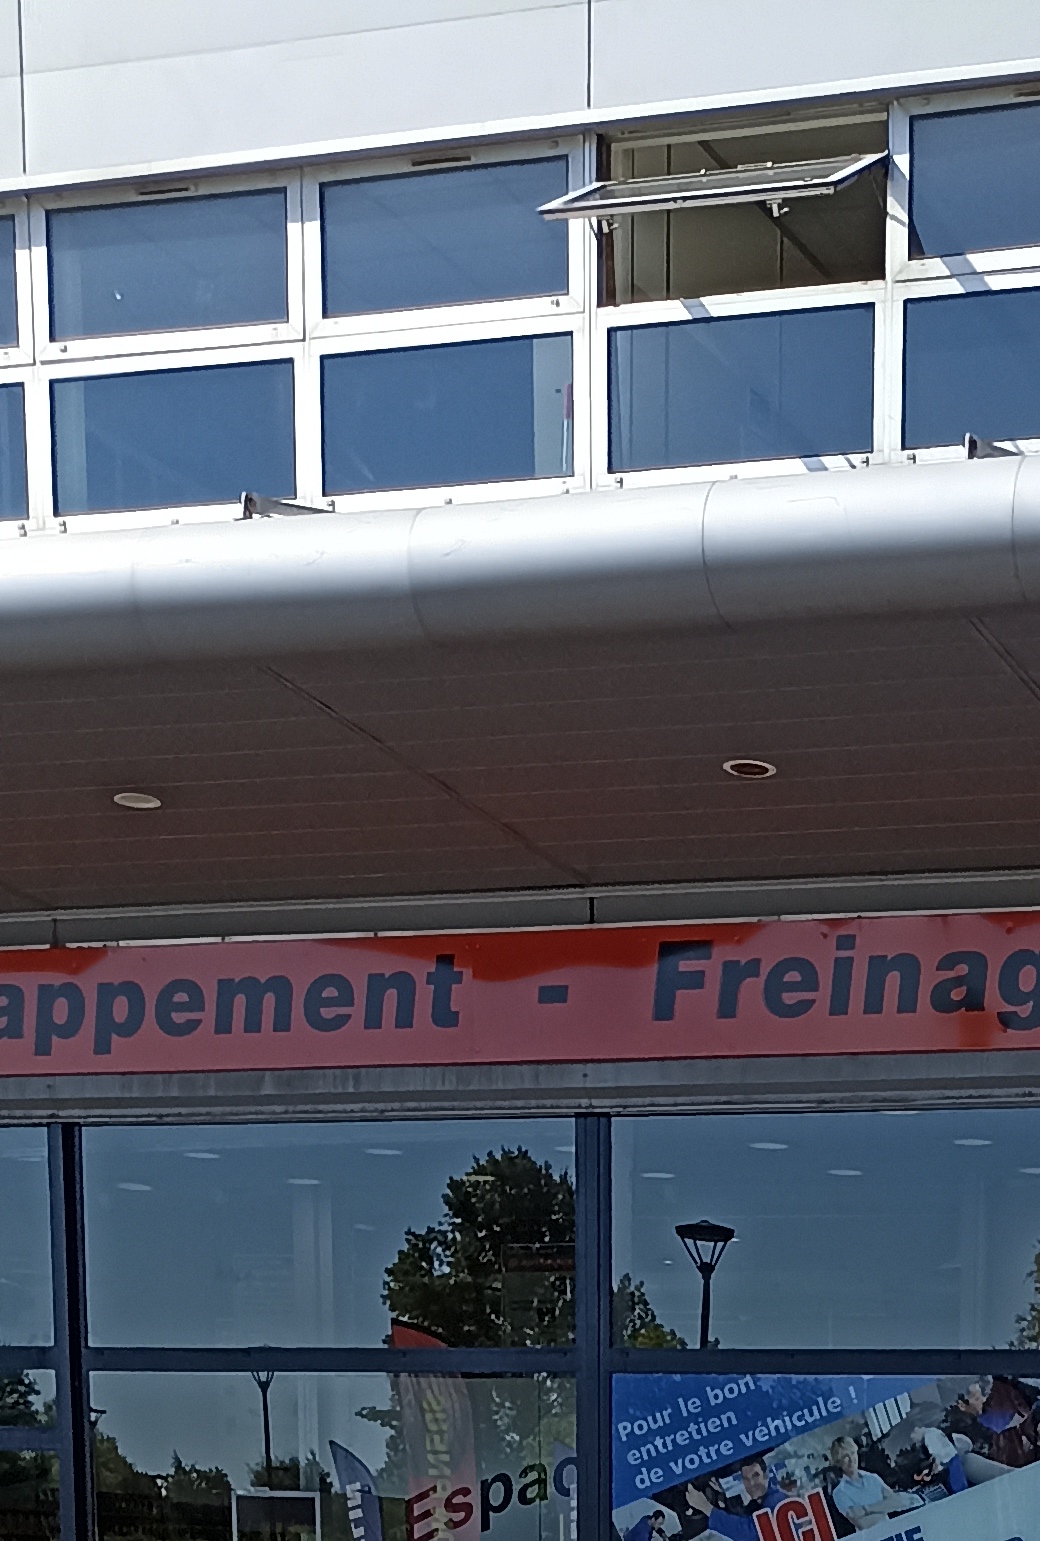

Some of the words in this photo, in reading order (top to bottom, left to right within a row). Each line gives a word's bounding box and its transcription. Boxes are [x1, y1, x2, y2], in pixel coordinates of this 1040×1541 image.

[617, 1406, 671, 1441] Pour
[677, 1397, 701, 1417] le
[706, 1375, 756, 1407] bon
[626, 1411, 737, 1465] entretien
[634, 1468, 664, 1489] de
[669, 1440, 734, 1475] votre
[739, 1396, 841, 1447] véhicule
